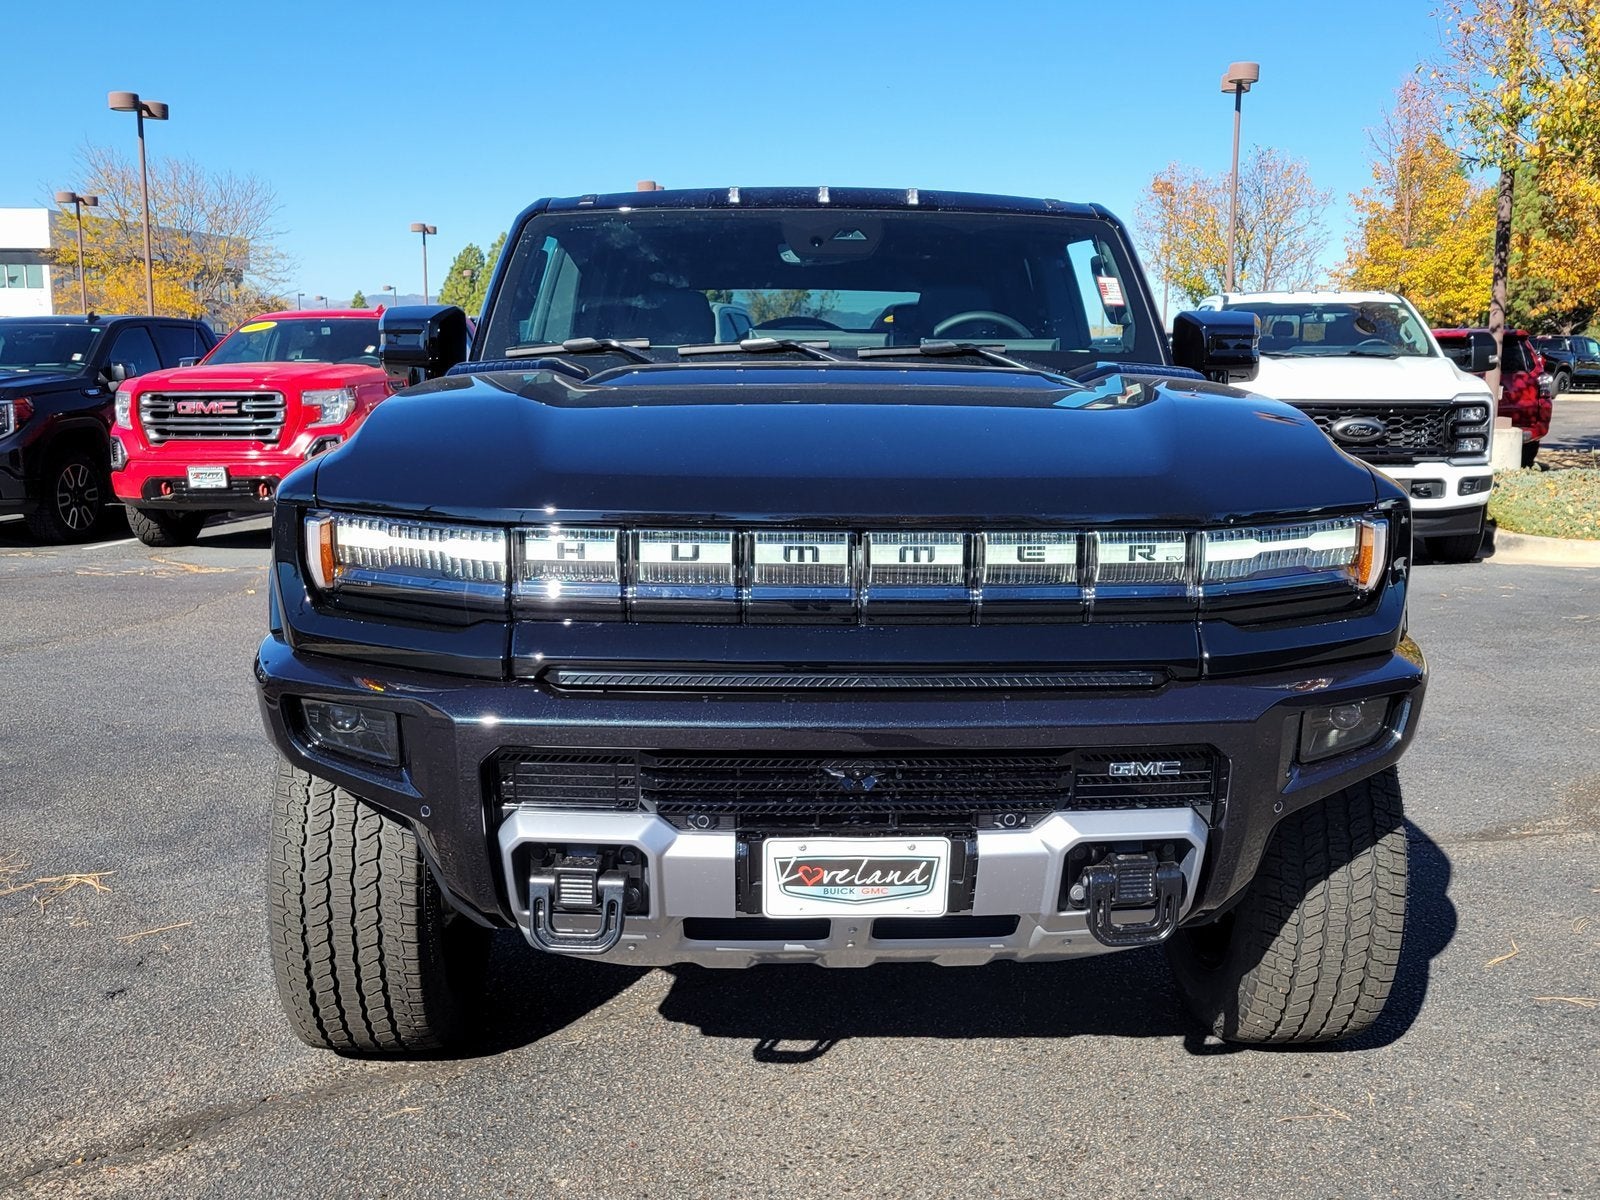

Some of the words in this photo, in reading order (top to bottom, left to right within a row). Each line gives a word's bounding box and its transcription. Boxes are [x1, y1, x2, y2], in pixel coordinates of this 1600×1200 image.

[176, 401, 239, 415] GMC
[1347, 425, 1373, 436] Ford
[556, 542, 1157, 563] HUMMER
[1109, 761, 1181, 776] GMC
[823, 887, 855, 895] BUICK
[861, 887, 889, 895] GMC
